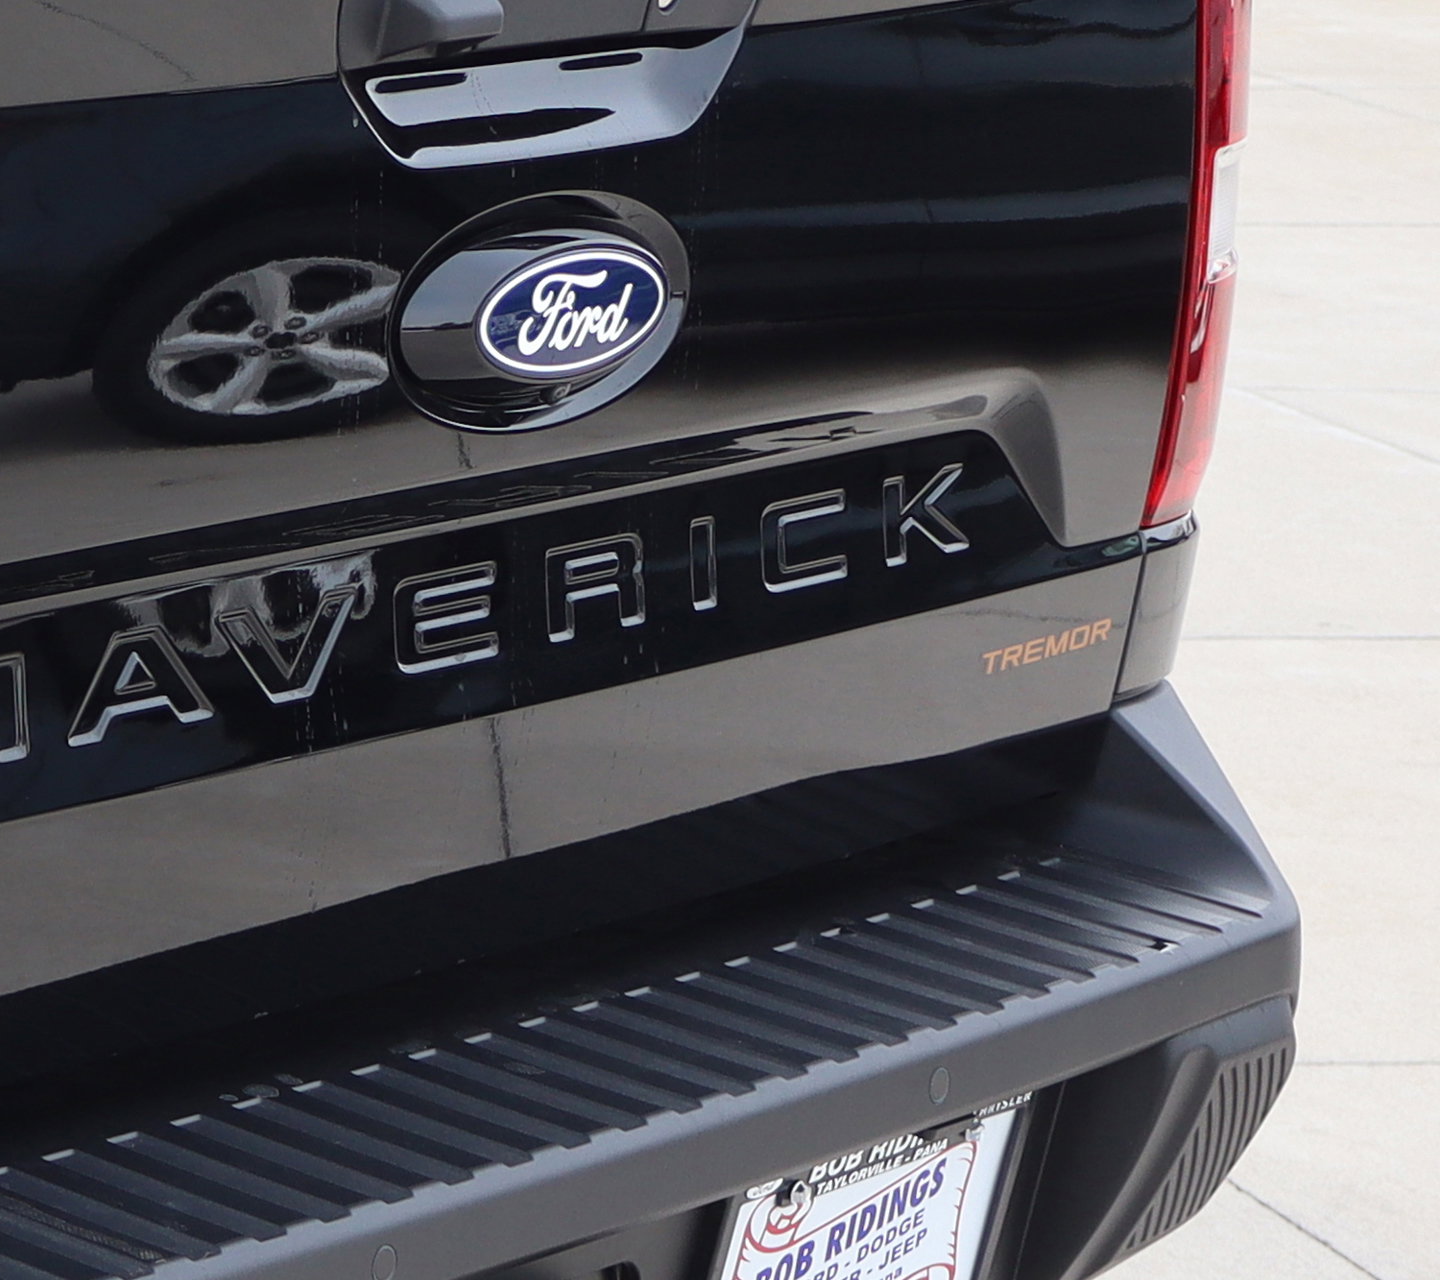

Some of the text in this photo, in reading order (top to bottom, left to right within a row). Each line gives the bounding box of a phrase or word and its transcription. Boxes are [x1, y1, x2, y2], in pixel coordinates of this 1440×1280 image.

[517, 269, 633, 355] Ford
[982, 618, 1113, 675] TREMOR
[816, 1157, 902, 1196] TAYLORVILLE
[914, 1138, 949, 1160] PANA
[825, 1157, 947, 1263] RIDINGS
[856, 1208, 926, 1264] DODGE
[877, 1227, 929, 1274] JEEP
